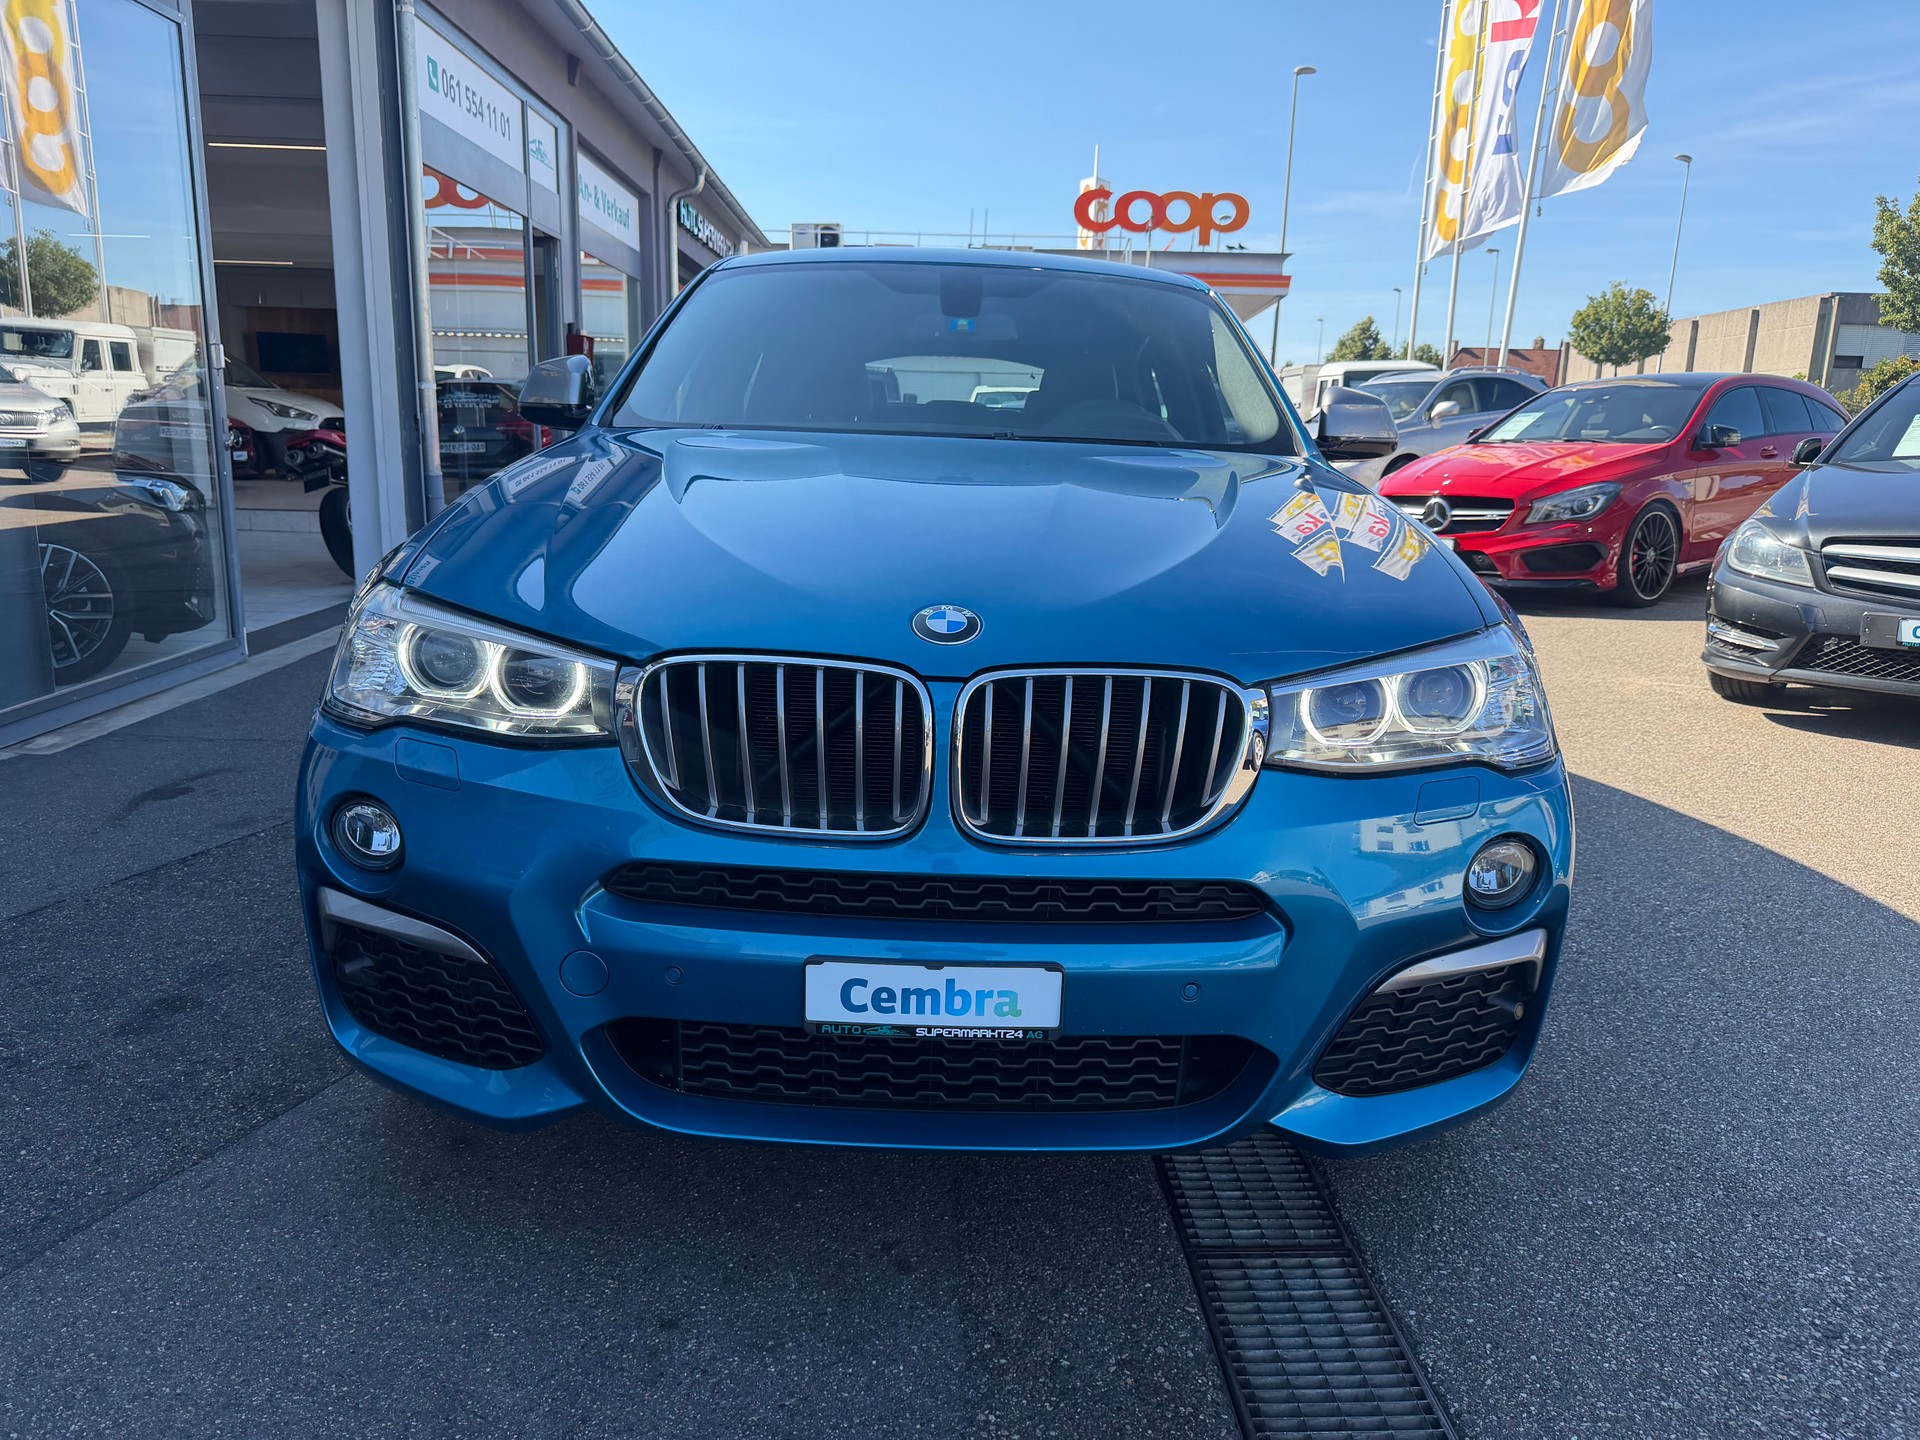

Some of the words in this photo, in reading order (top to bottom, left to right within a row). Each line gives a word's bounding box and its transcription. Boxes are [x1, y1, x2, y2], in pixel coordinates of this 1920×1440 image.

[441, 68, 461, 107] 061
[465, 85, 484, 123] 554
[487, 102, 498, 133] 11
[500, 111, 511, 142] 01
[594, 185, 600, 209] &
[601, 190, 630, 231] Verkauf
[1074, 188, 1250, 246] coop
[921, 604, 976, 618] BMW
[839, 977, 1023, 1018] Cembra
[821, 1024, 862, 1035] AUTO
[915, 1027, 1024, 1039] SUPERMARKT24
[1026, 1030, 1044, 1040] AG
